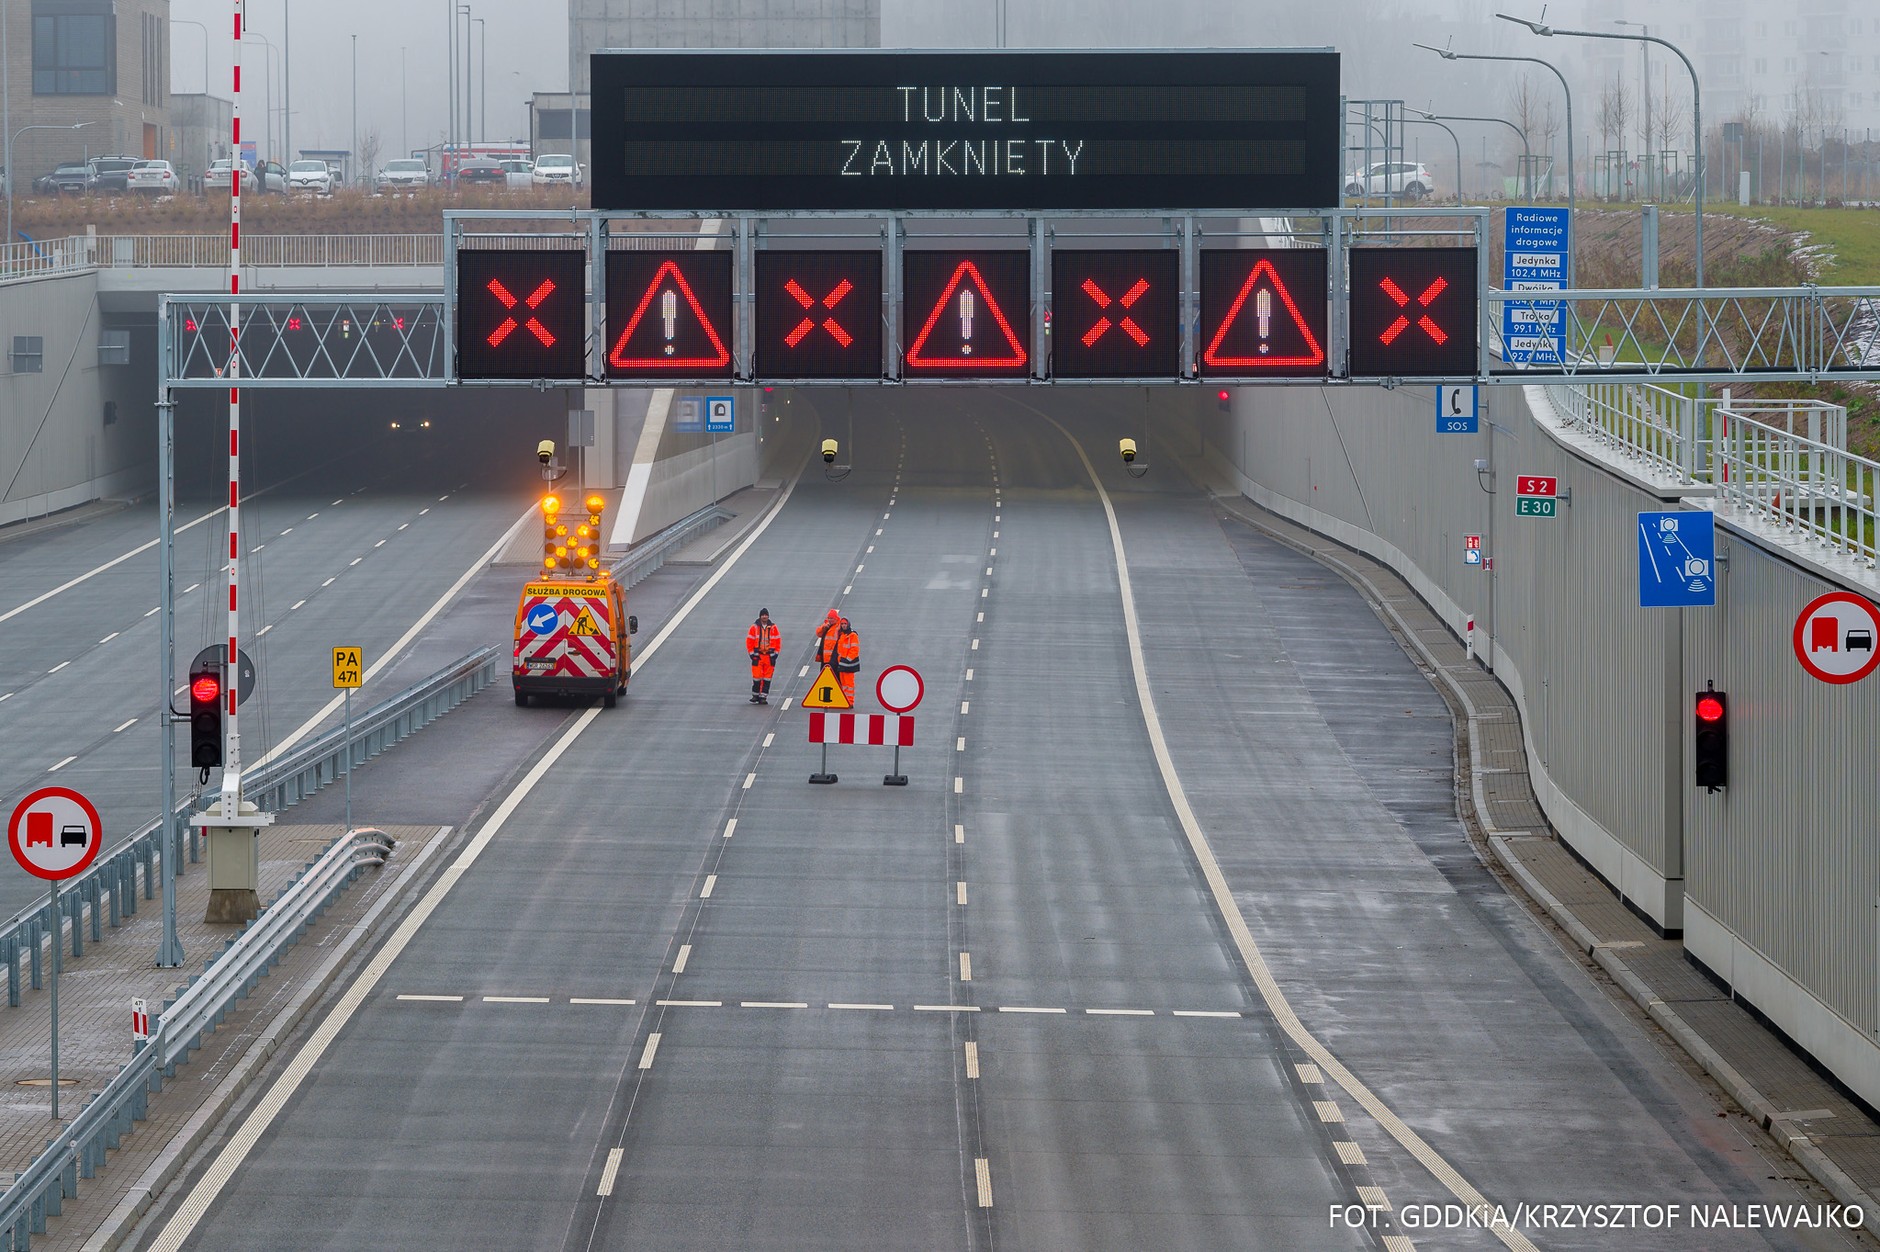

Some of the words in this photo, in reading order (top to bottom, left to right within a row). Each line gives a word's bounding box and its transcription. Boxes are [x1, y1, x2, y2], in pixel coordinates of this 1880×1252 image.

[896, 86, 1030, 122] TUNEL
[841, 140, 1083, 176] ZAMKNIĘTY
[1516, 213, 1558, 222] Radiowe
[1511, 225, 1563, 236] informacje
[1515, 237, 1558, 248] drogowe
[1516, 255, 1556, 266] Jedynka
[1540, 269, 1561, 278] MHz
[1536, 352, 1557, 361] MHz
[1447, 421, 1468, 431] SOS
[1521, 500, 1529, 513] E
[1532, 501, 1551, 514] 30
[527, 587, 561, 596] SŁUŻBA
[562, 588, 606, 597] DROGOWA
[336, 652, 358, 666] PA
[338, 671, 357, 682] 471
